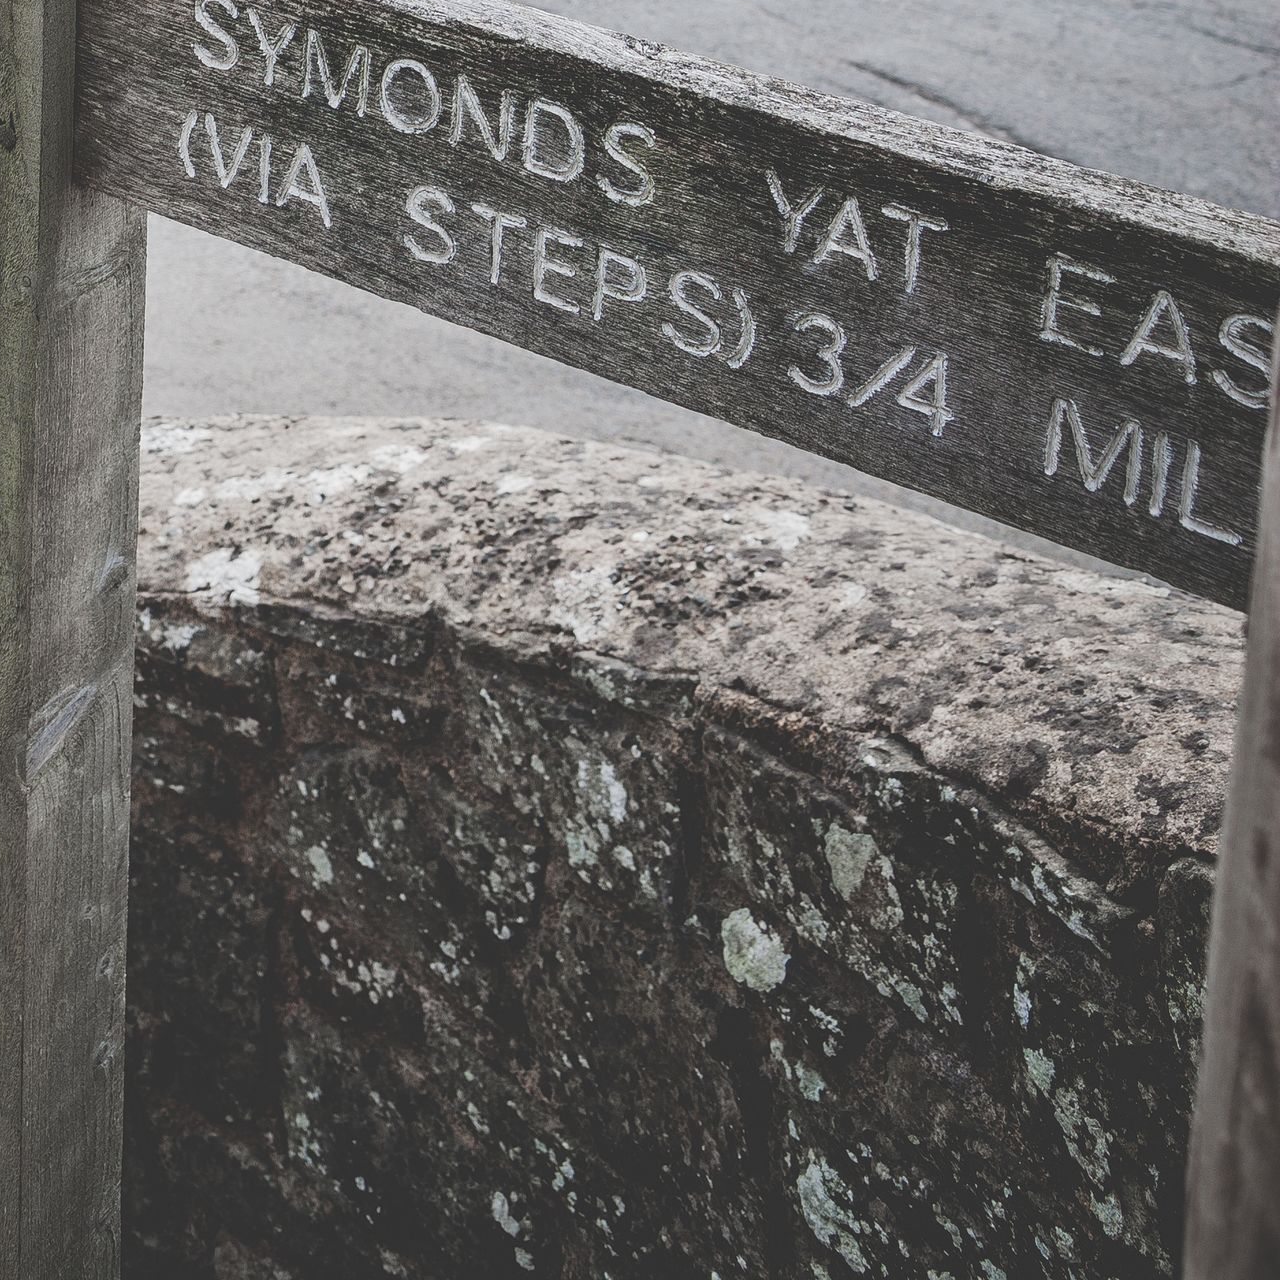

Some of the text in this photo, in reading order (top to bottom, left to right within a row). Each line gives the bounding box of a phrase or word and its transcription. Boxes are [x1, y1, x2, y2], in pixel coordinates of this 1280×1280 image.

[177, 111, 333, 229] (VIA
[402, 184, 756, 370] STEPS)
[785, 312, 955, 438] 3/4
[765, 168, 949, 293] YAT
[1038, 251, 1278, 409] EAS
